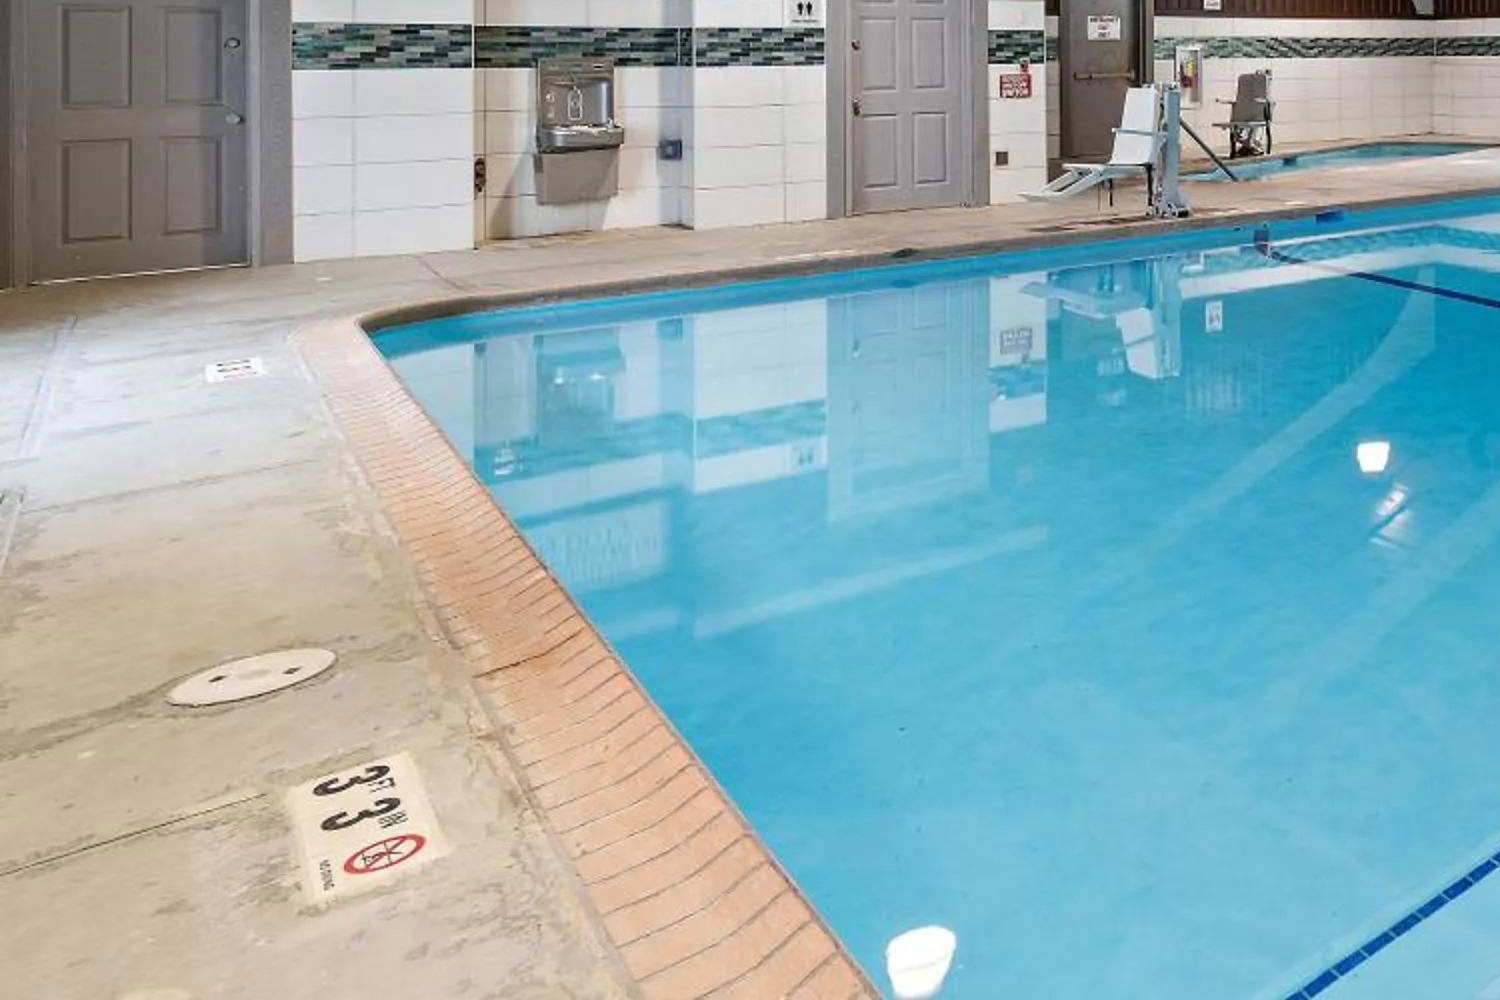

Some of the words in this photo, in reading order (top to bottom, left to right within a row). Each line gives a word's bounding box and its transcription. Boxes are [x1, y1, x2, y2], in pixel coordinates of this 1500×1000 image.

[313, 765, 391, 797] 3
[368, 777, 396, 794] FT
[320, 797, 401, 831] 3
